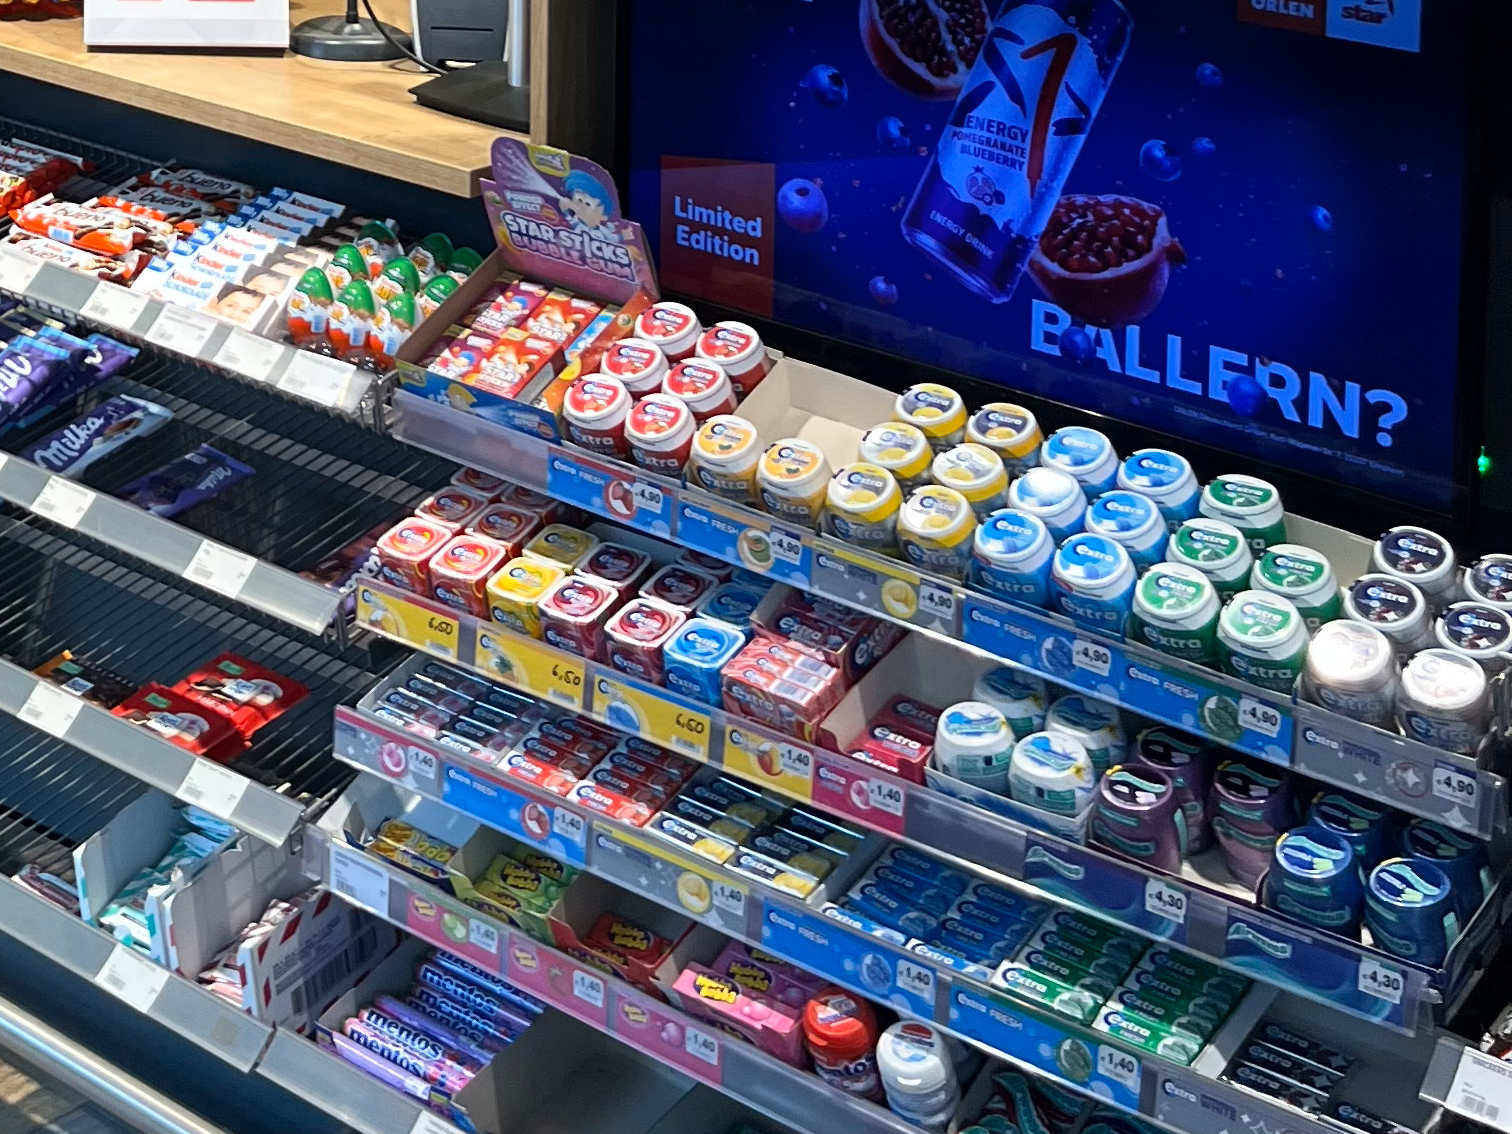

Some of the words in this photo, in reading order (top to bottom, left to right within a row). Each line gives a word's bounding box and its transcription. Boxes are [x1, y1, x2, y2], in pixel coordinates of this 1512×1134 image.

[951, 130, 1027, 159] POMEGRANATE
[967, 114, 1029, 143] ENERGY
[960, 142, 1025, 172] BLUEBERRY
[53, 205, 108, 223] bueno
[139, 190, 194, 209] bueno
[674, 195, 762, 238] Limited
[505, 213, 556, 246] STAR
[561, 227, 631, 266] STICKS
[676, 224, 760, 266] Edition
[929, 210, 966, 239] ENERGY
[1031, 298, 1408, 448] BALLERN?
[33, 414, 105, 470] Milka
[348, 1026, 426, 1077] mentos
[367, 1008, 444, 1061] mentos
